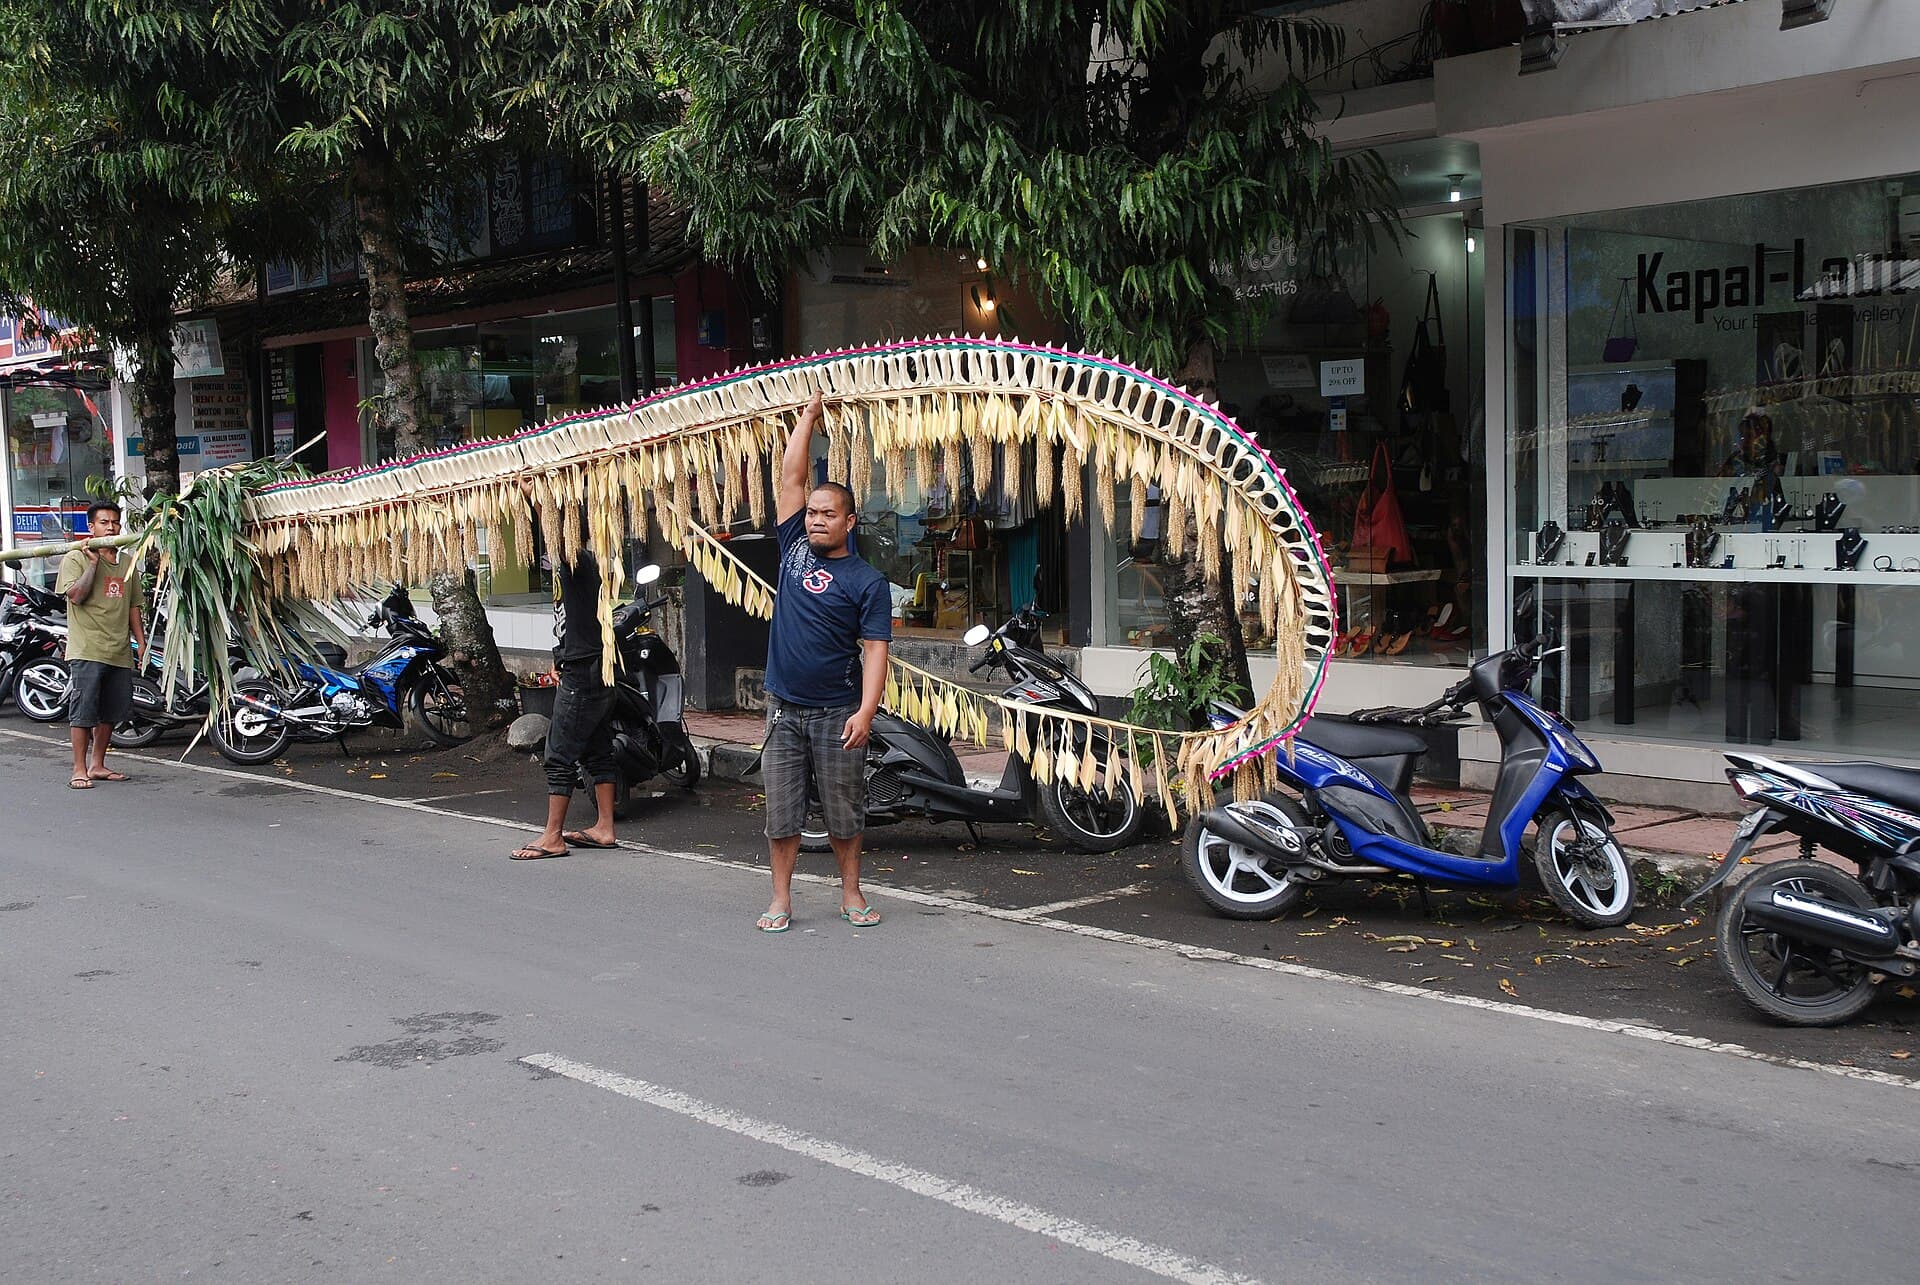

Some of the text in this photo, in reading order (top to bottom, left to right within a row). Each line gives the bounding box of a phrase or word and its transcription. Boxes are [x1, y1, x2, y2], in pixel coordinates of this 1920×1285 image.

[1713, 314, 1748, 333] Your
[1850, 304, 1907, 325] wellery
[1331, 366, 1354, 374] UP TO
[1342, 377, 1357, 385] OFF
[195, 394, 242, 404] RENT A CAR
[197, 406, 241, 416] MOTOR BIKE
[16, 514, 39, 526] DELTA
[1034, 680, 1061, 697] HONDA
